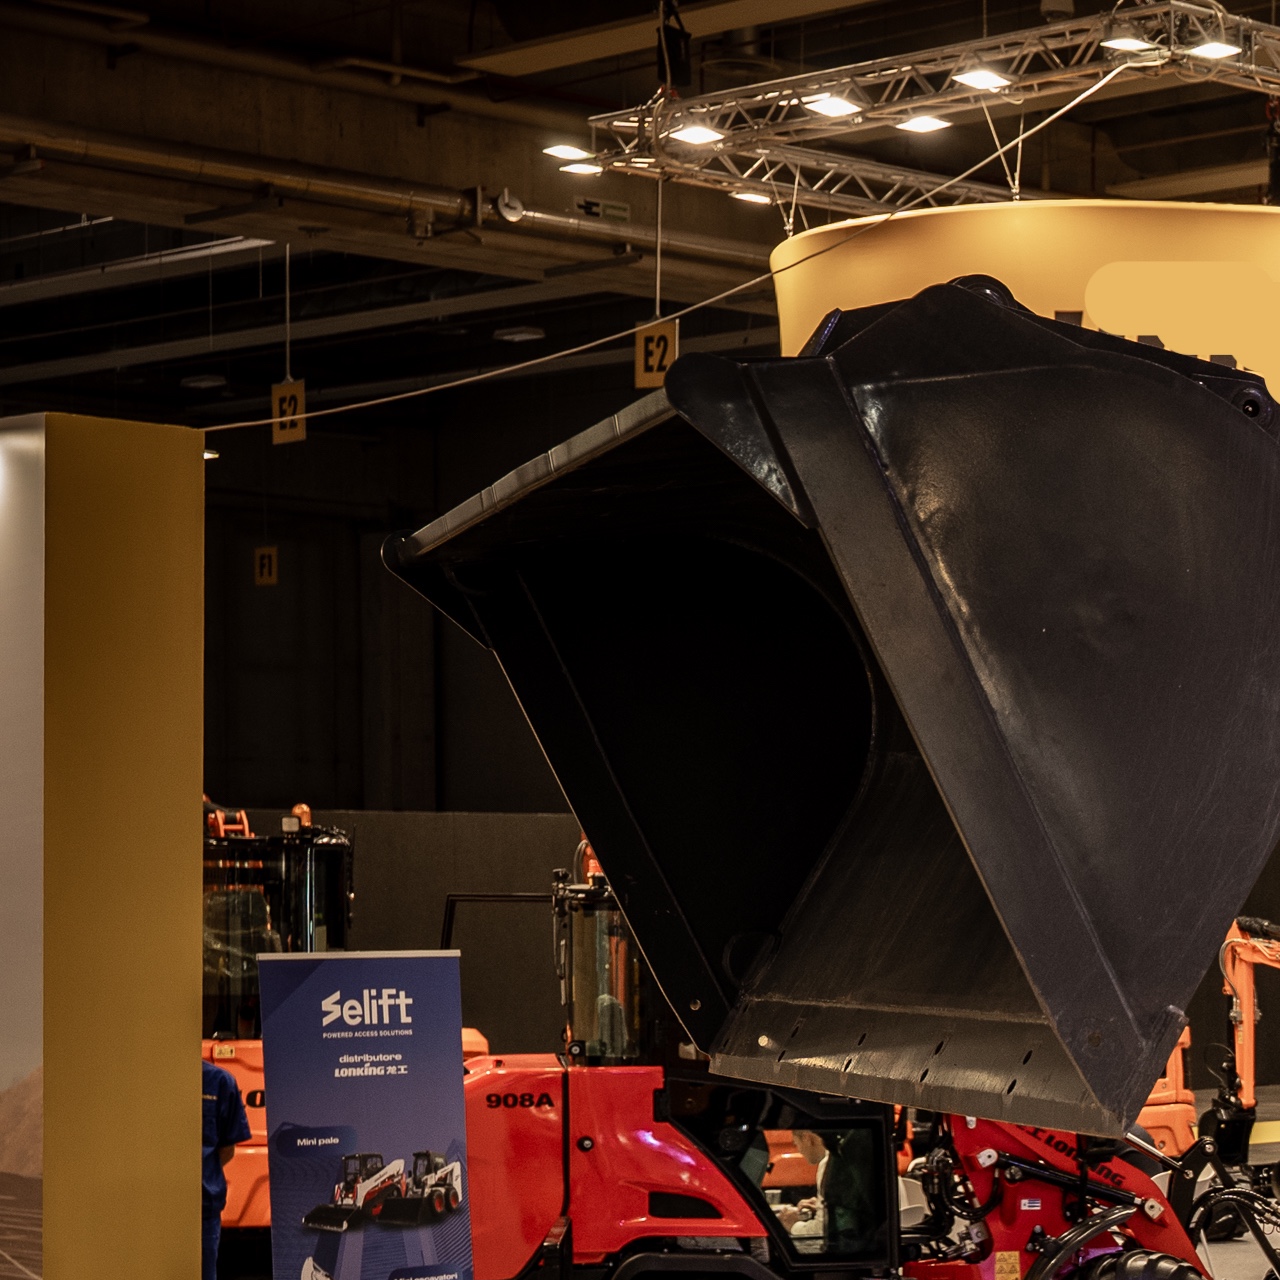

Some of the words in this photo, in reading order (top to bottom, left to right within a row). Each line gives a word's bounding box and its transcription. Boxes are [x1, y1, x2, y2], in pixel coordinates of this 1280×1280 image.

[644, 335, 670, 373] E2
[278, 395, 299, 431] E2
[259, 555, 273, 577] F1
[321, 988, 413, 1027] Selift
[323, 1031, 353, 1039] POWERED
[354, 1030, 378, 1038] ACCESS
[379, 1028, 413, 1037] SOLUTIONS
[339, 1054, 402, 1063] distributore
[485, 1092, 555, 1109] 908A
[297, 1138, 317, 1147] Mini
[318, 1137, 340, 1146] pale
